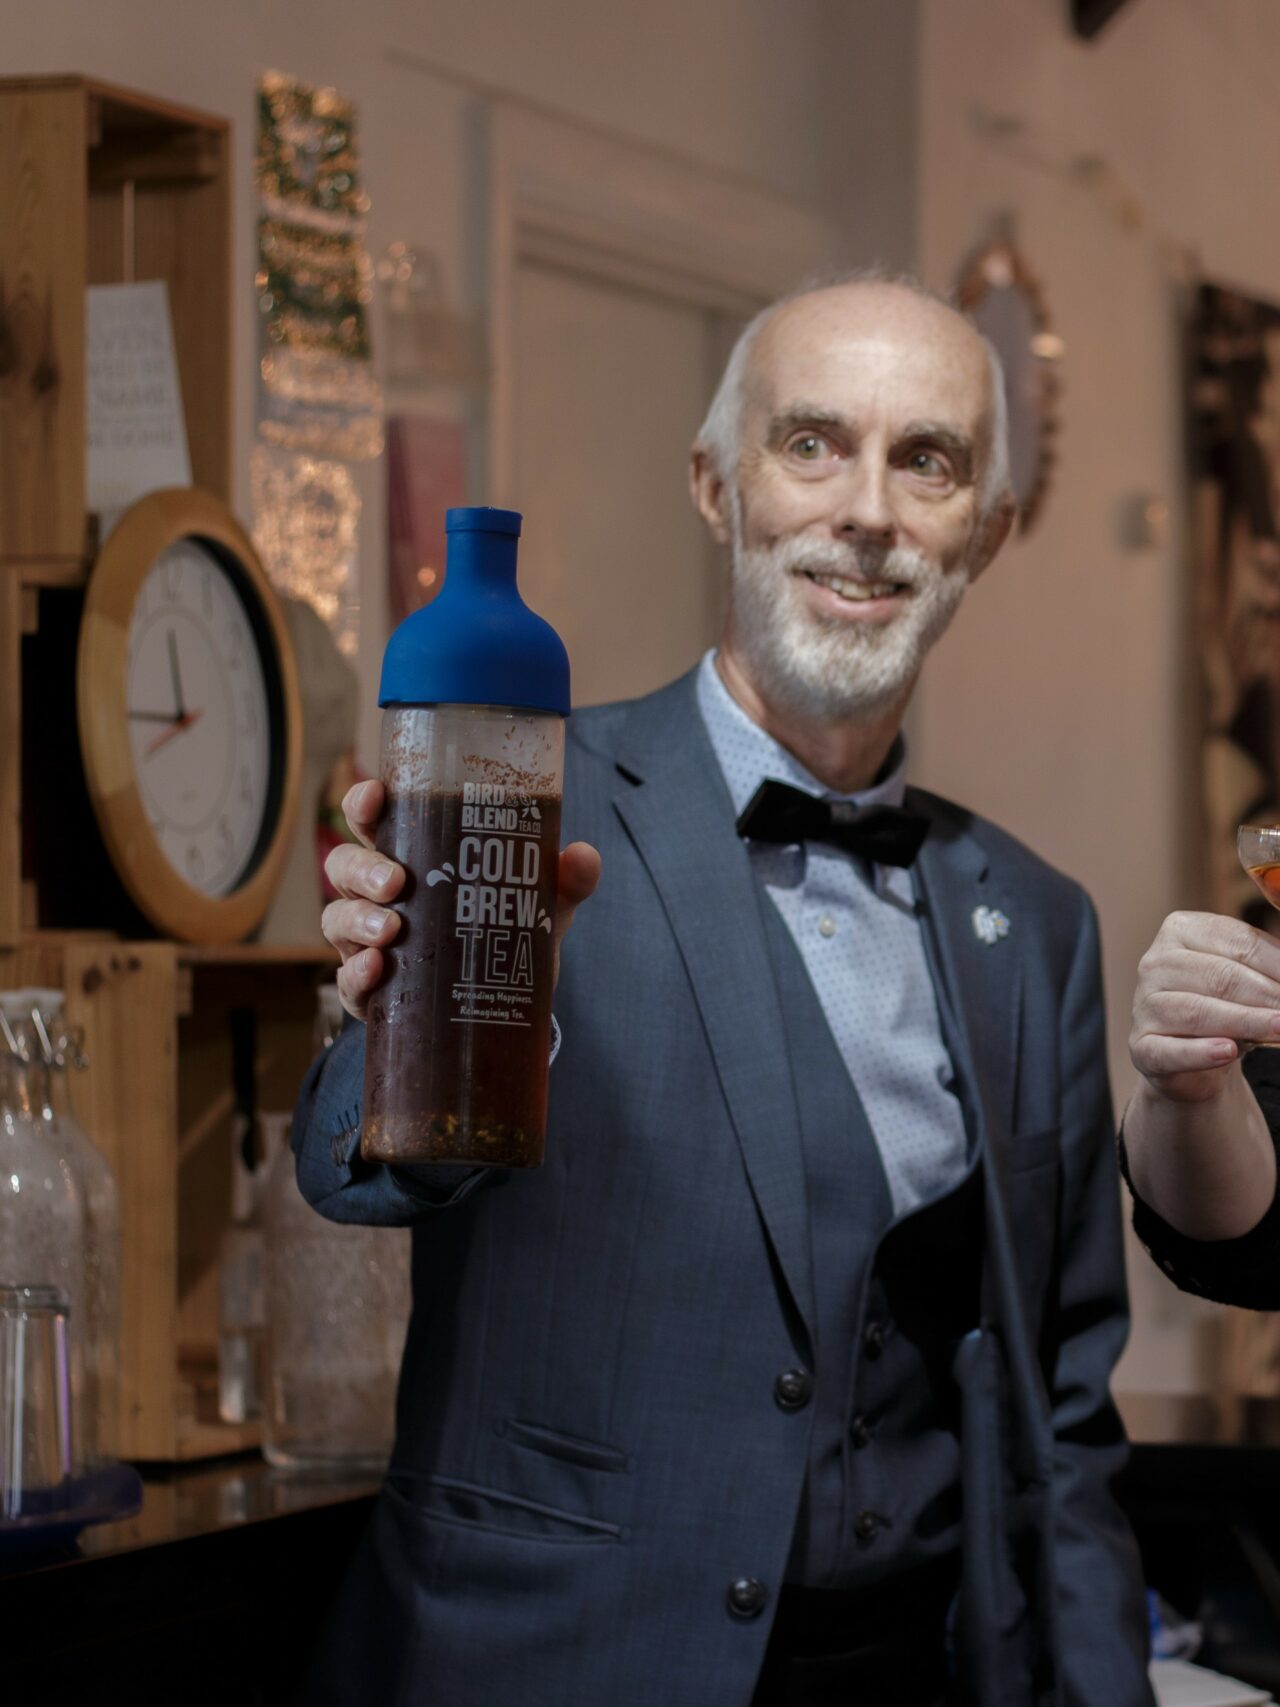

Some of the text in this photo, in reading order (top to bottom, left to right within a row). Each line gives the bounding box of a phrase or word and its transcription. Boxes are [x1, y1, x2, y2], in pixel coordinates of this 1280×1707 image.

[461, 805, 518, 830] BLEND
[519, 820, 532, 832] TEA
[458, 836, 540, 885] COLD
[455, 884, 538, 928] BREW
[455, 927, 533, 985] TEA
[451, 989, 495, 1003] Spreading
[460, 1006, 509, 1020] Reimagining
